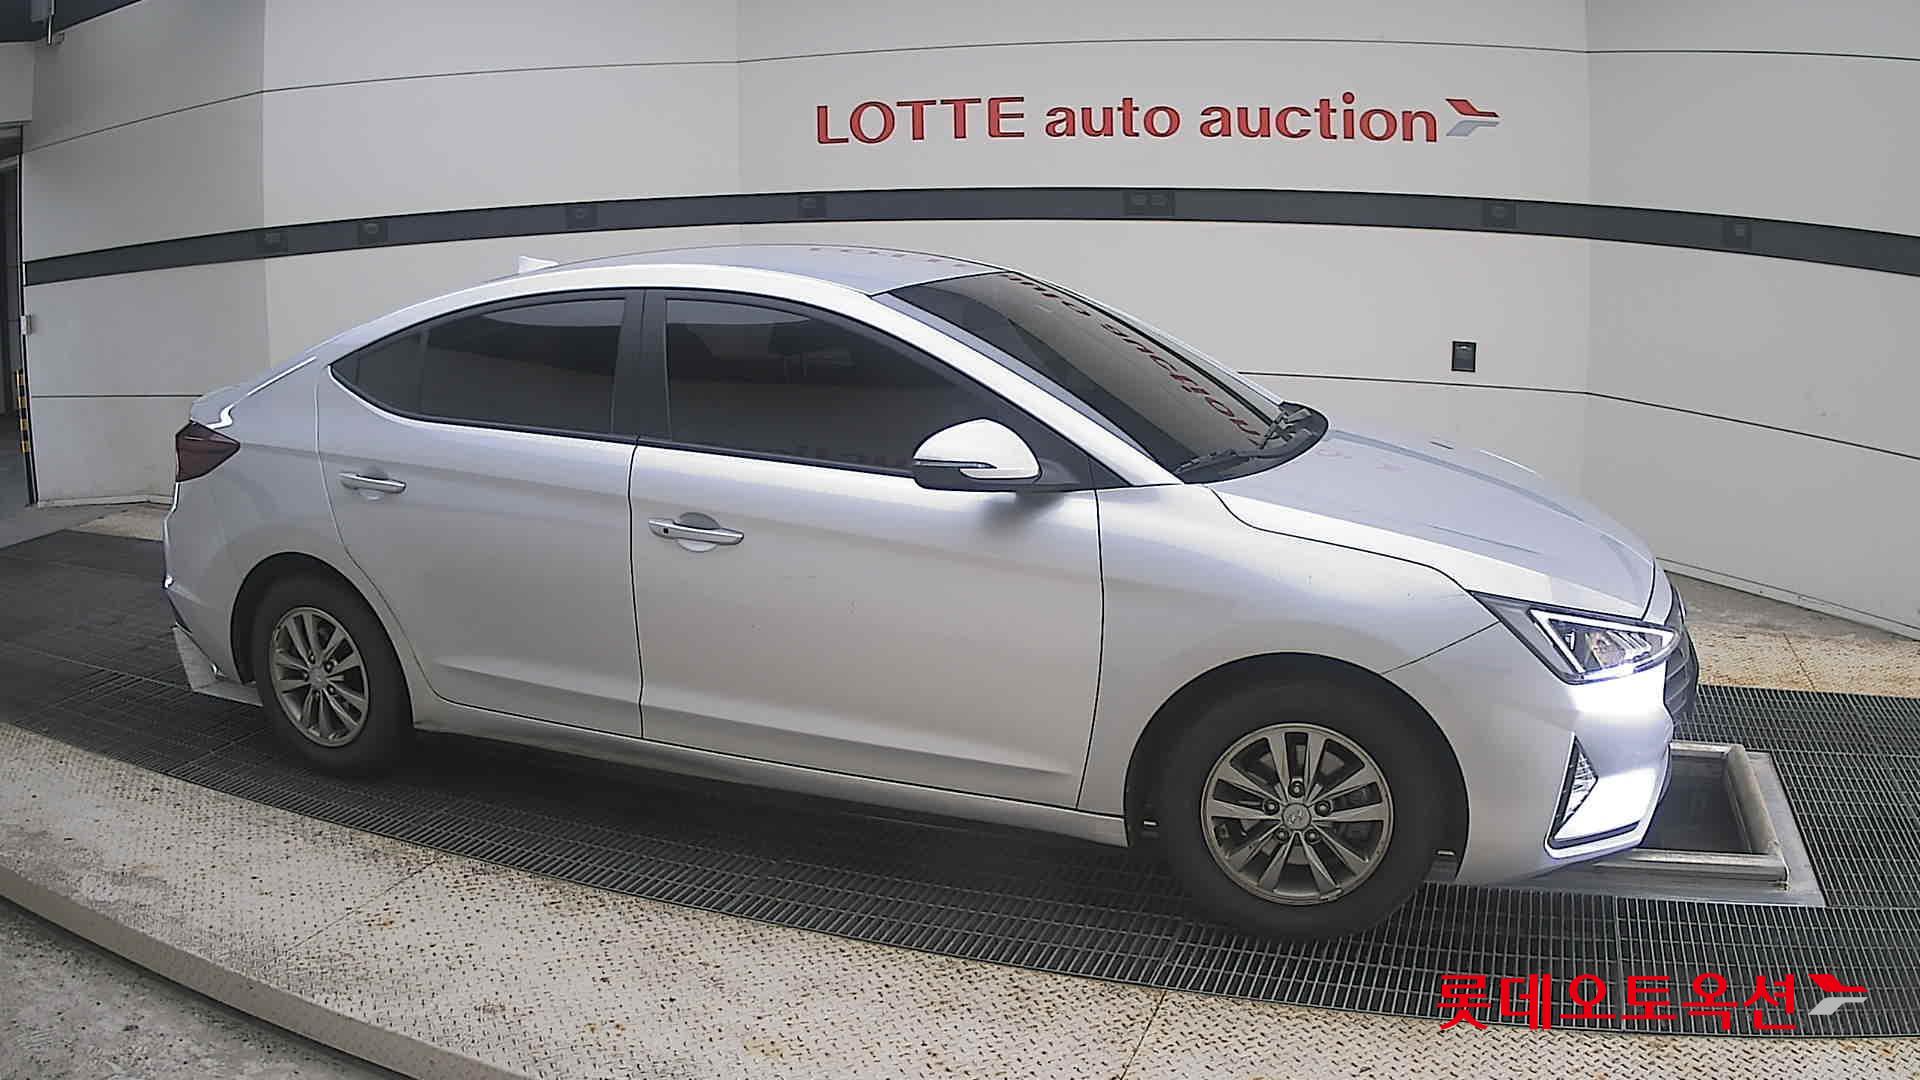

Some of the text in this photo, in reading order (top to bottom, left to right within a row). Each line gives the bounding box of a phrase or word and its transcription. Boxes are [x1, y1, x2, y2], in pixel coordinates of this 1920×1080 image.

[815, 91, 1438, 145] LOTTE auto auction
